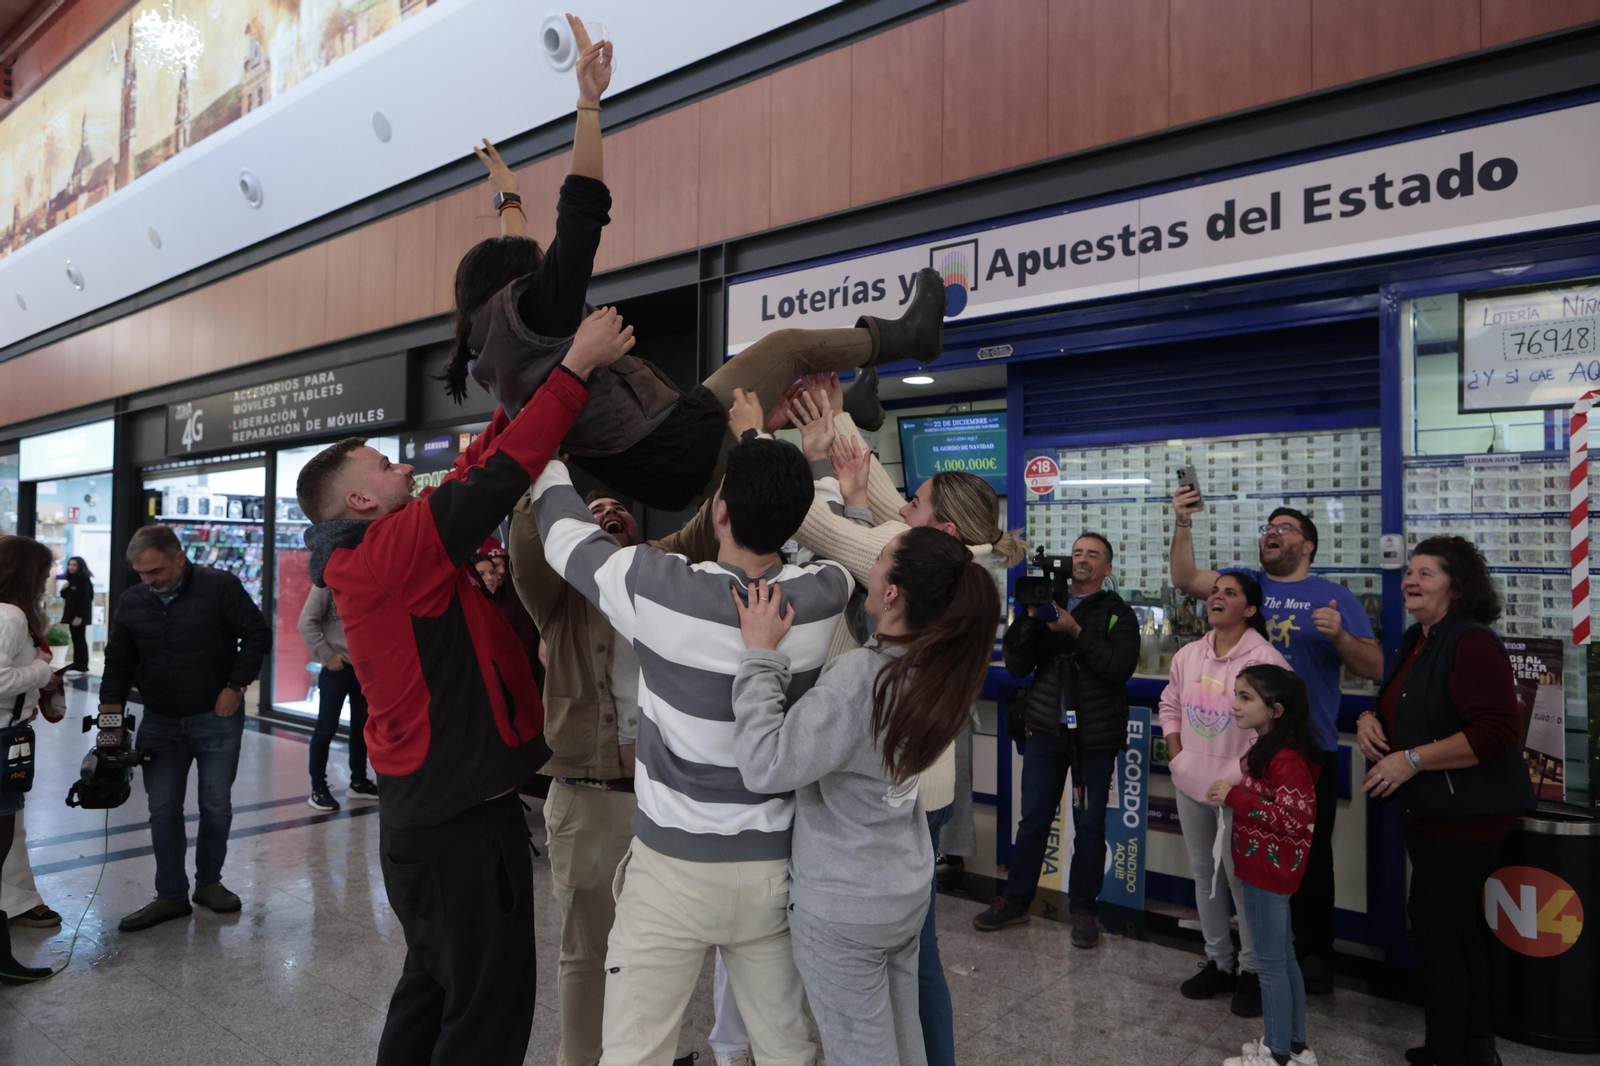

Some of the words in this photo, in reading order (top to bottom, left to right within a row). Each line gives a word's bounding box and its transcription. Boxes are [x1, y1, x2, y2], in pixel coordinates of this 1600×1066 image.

[761, 275, 886, 321] Loterías
[898, 271, 919, 306] y
[985, 221, 1189, 288] Apuestas
[1206, 191, 1282, 242] del
[1303, 151, 1518, 225] Estado
[1510, 327, 1589, 355] 76918
[233, 380, 299, 402] ACCESORIOS
[304, 371, 335, 387] PARA
[1529, 369, 1555, 382] CAE
[233, 395, 276, 414] MÓVILES
[280, 395, 288, 406] Y
[293, 383, 343, 402] TABLETS
[181, 409, 204, 452] 4G
[232, 421, 300, 443] REPARACIÓN
[306, 418, 321, 432] DE
[327, 408, 385, 428] MÓVILES
[233, 408, 297, 430] LIBERACIÓN
[301, 407, 310, 418] Y
[952, 418, 988, 427] DICIEMBRE
[424, 440, 449, 451] SAMSUNG
[934, 457, 997, 471] 4.000.000€
[1031, 460, 1051, 473] +18
[1264, 596, 1282, 609] The
[1284, 598, 1311, 610] Move
[1525, 655, 1541, 664] AL
[1517, 671, 1540, 680] SER
[1534, 713, 1550, 722] EURO
[1126, 720, 1143, 745] EL
[1122, 748, 1142, 829] GORDO
[1126, 837, 1138, 893] VENDIDO
[1484, 877, 1584, 944] N4
